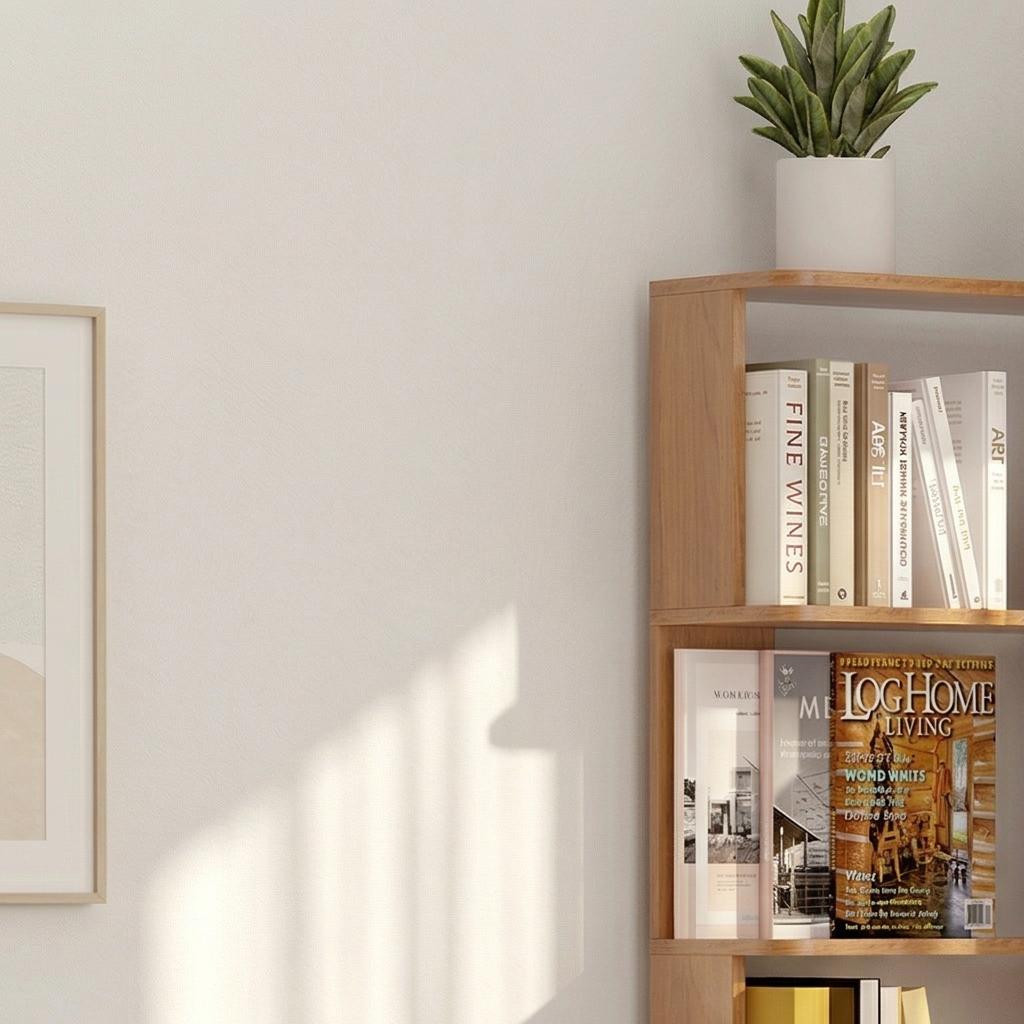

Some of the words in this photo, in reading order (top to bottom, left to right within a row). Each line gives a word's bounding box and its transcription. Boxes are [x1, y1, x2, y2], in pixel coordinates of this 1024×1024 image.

[785, 402, 804, 466] FINE
[991, 427, 1006, 465] ART
[785, 480, 804, 573] WINES
[886, 716, 952, 738] LIVING
